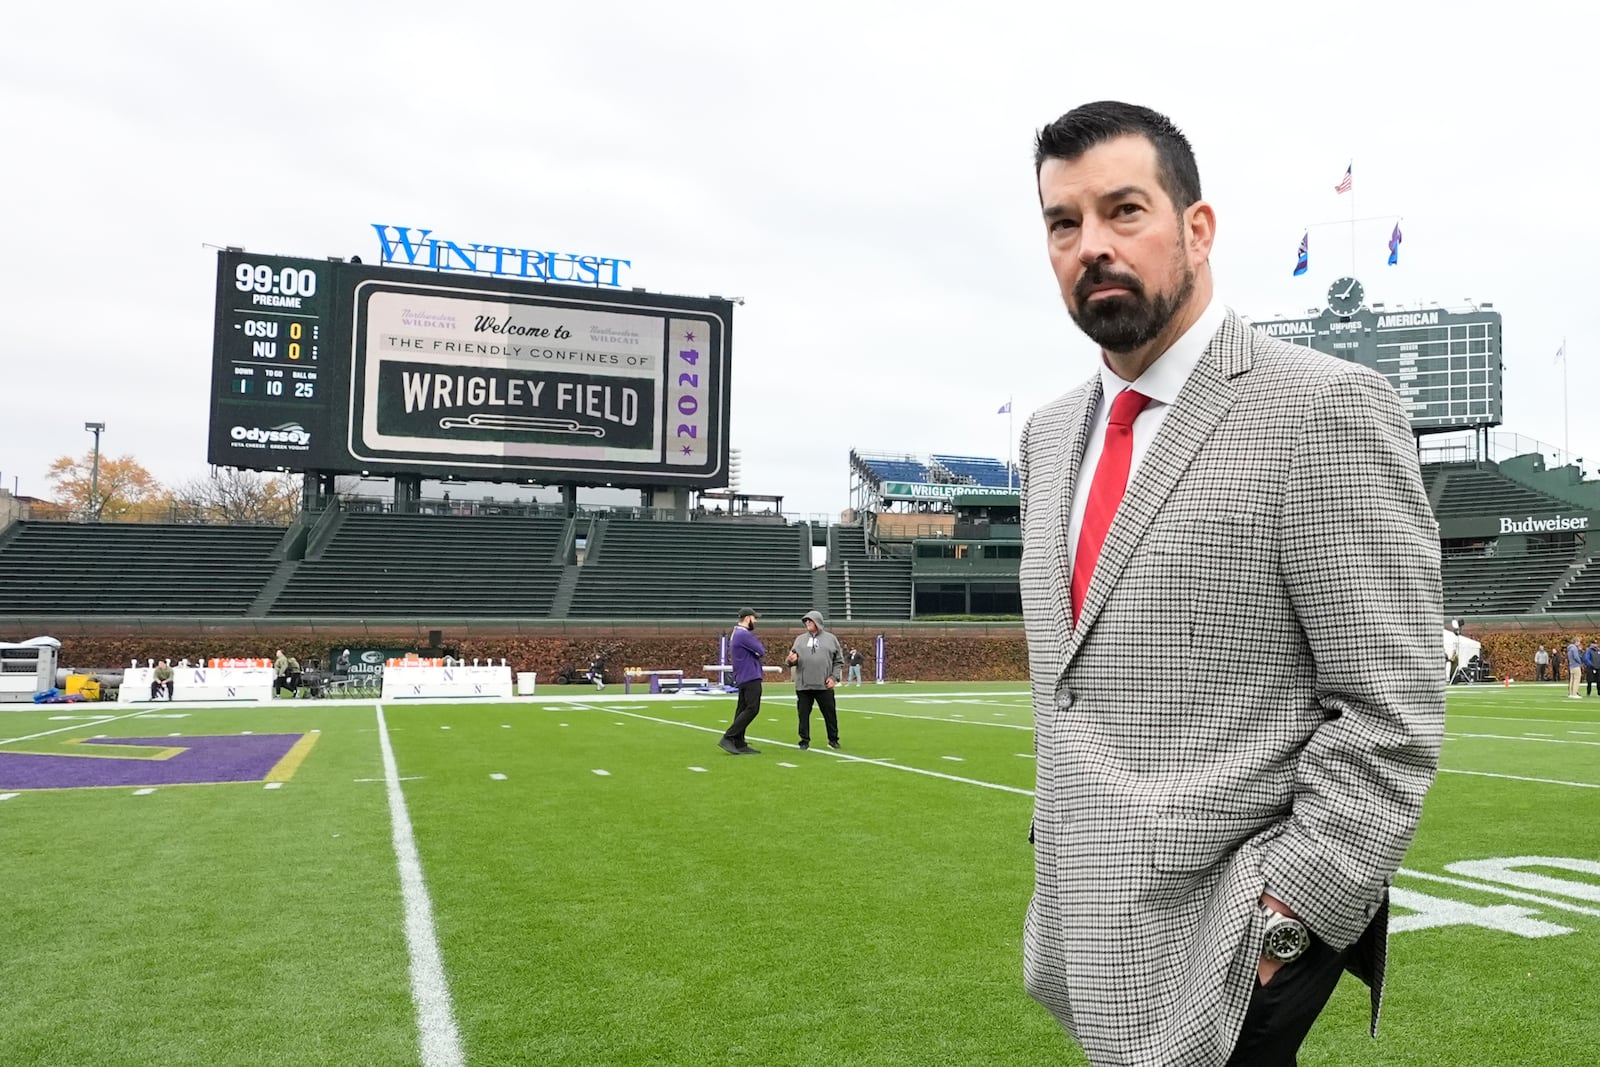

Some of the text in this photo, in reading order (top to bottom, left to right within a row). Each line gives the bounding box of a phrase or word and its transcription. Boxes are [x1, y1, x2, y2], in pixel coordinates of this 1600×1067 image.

[370, 223, 632, 288] WINTRUST
[235, 263, 316, 297] 99:00
[252, 294, 302, 309] PREGAME
[244, 319, 302, 340] OSU 0
[473, 313, 573, 340] Welcome to
[1256, 320, 1316, 337] NATIONAL
[1329, 320, 1363, 331] UMPIRES
[1376, 312, 1439, 329] AMERICAN
[252, 341, 301, 360] NU 0
[388, 337, 650, 367] THE FRIENDLY CONFINES OF
[266, 380, 283, 397] 10
[294, 382, 314, 398] 25
[401, 369, 638, 427] WRIGLEY FIELD
[676, 347, 701, 440] 2024
[230, 425, 312, 446] Odyssey
[1499, 515, 1588, 534] Budweiser
